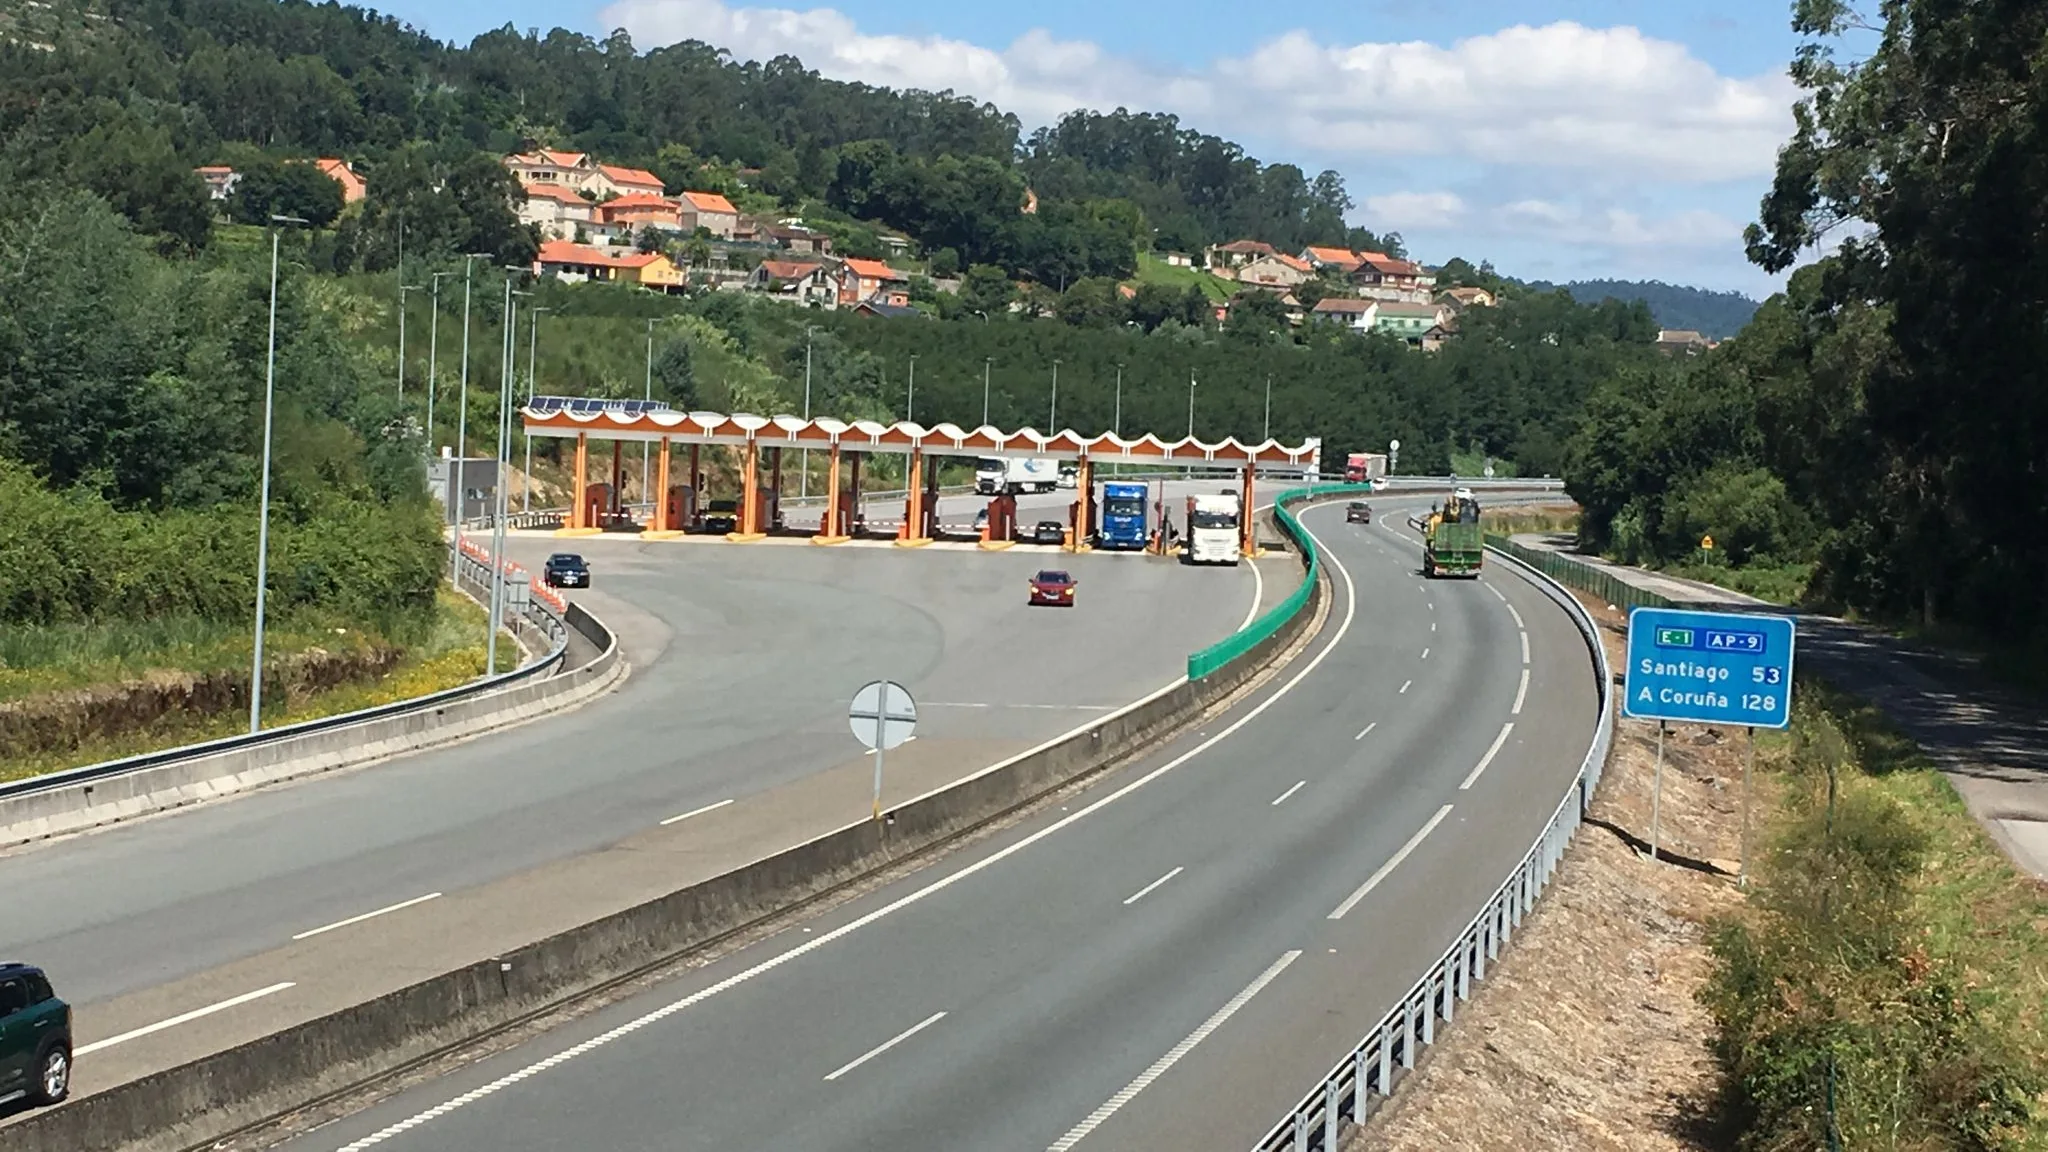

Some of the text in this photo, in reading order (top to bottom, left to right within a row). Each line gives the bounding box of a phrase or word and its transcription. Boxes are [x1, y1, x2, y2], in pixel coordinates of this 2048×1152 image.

[1661, 631, 1690, 644] E-1
[1711, 635, 1759, 648] AP-9
[1640, 658, 1781, 684] Santiago 53
[1638, 686, 1777, 711] A Coruña 128
